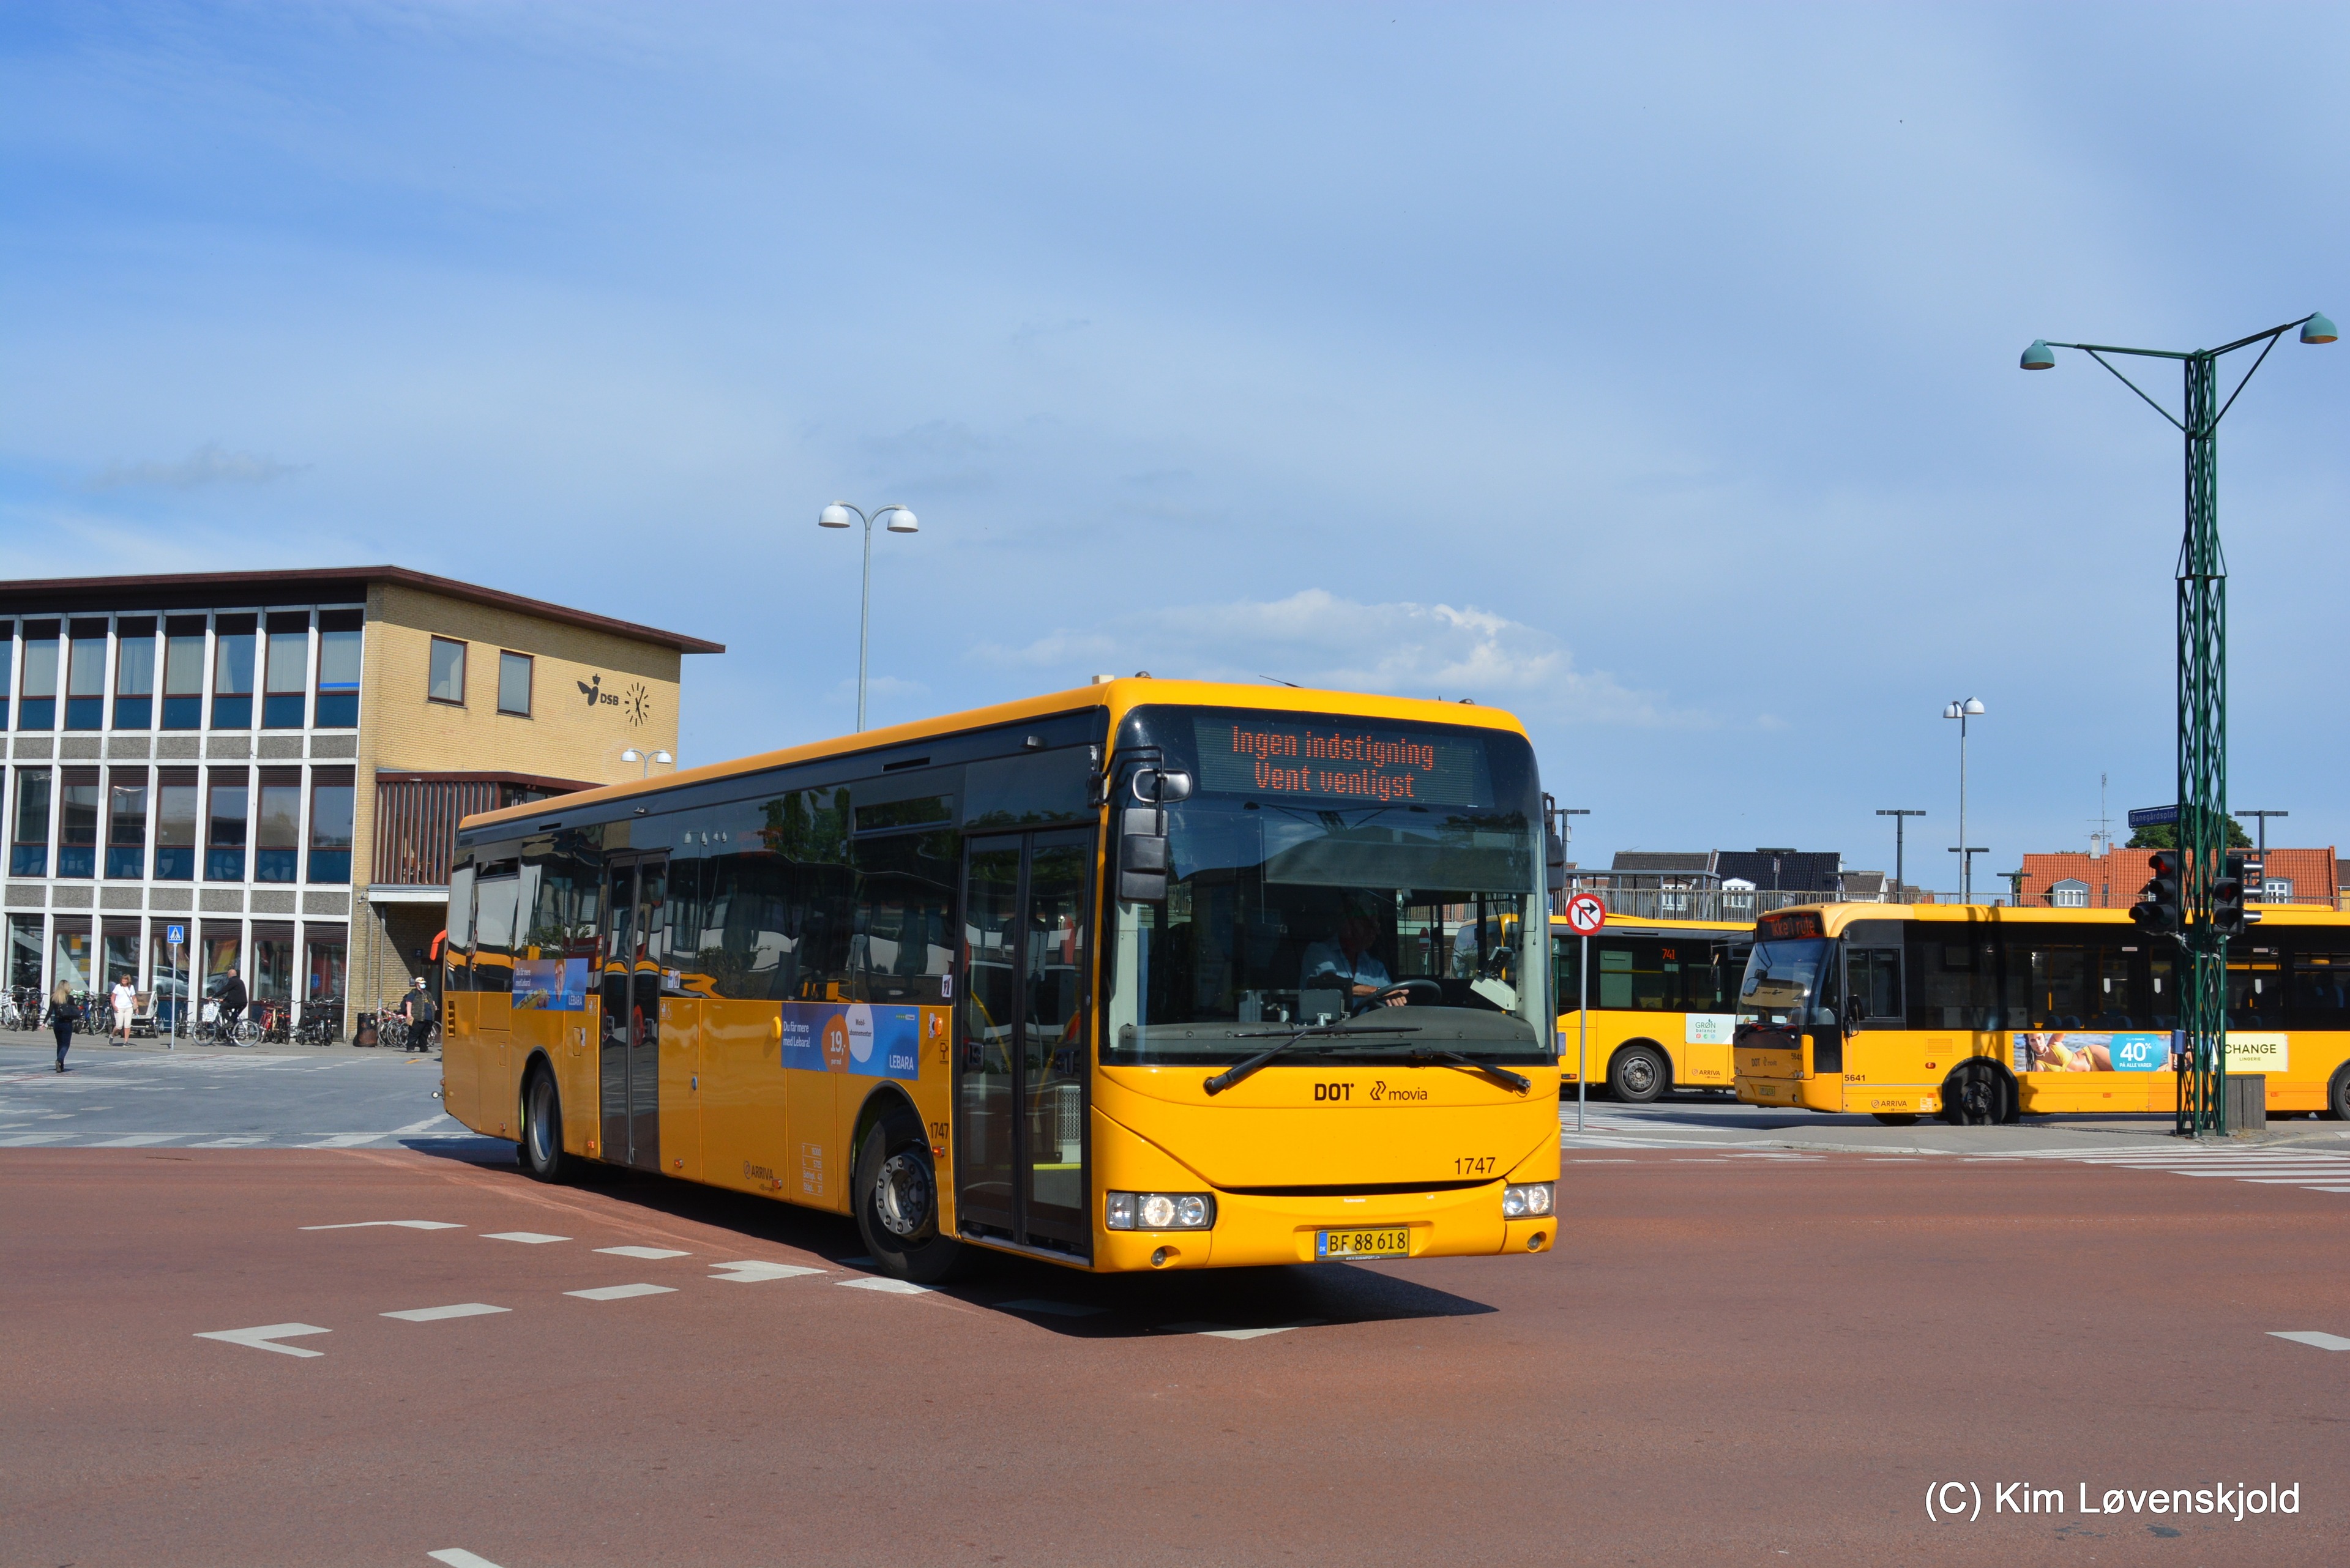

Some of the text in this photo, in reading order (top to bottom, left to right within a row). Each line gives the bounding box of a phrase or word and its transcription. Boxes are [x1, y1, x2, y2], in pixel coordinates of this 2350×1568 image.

[600, 693, 619, 706] DSB
[1233, 726, 1433, 771] Ingen indstigning
[1255, 762, 1414, 801] Vent venligst
[2131, 810, 2177, 822] Banegårdsplad
[1796, 916, 1815, 935] rute
[1662, 949, 1676, 960] 741
[783, 1021, 789, 1032] Du
[797, 1025, 809, 1033] mere
[783, 1037, 810, 1047] med Lebara!
[2225, 1044, 2277, 1054] CHANGE
[2120, 1042, 2152, 1061] 40%
[889, 1055, 914, 1070] LEBARA
[1751, 1058, 1760, 1067] DOT
[1315, 1083, 1428, 1101] DOT movia
[930, 1122, 949, 1140] 1747
[751, 1165, 774, 1181] ARRIVA
[1455, 1157, 1496, 1175] 1747
[1330, 1231, 1406, 1252] BF 88 618
